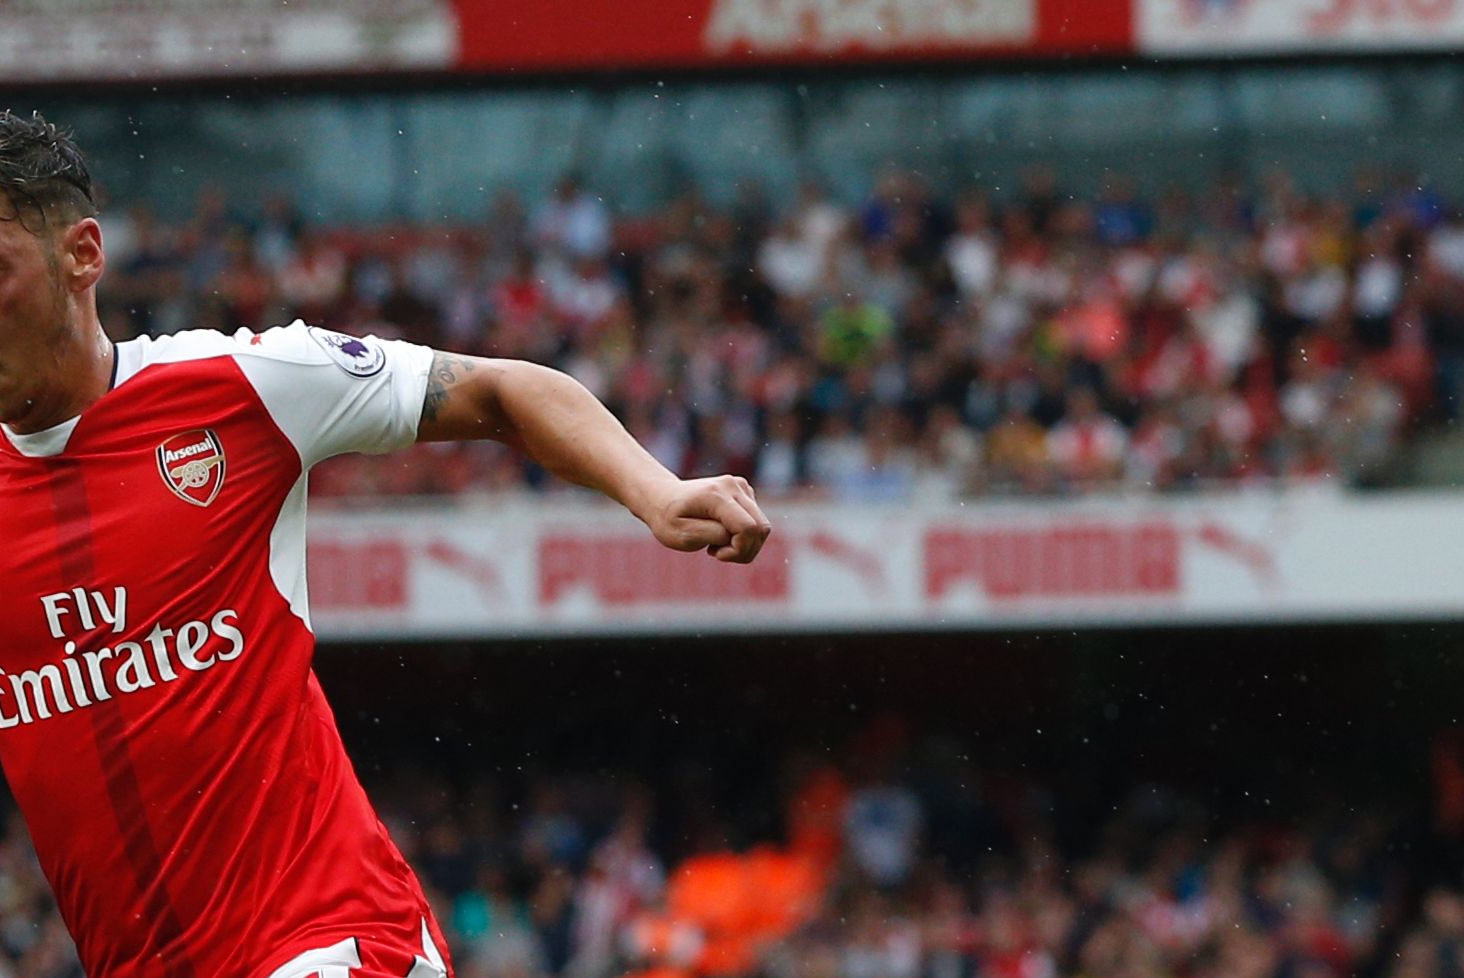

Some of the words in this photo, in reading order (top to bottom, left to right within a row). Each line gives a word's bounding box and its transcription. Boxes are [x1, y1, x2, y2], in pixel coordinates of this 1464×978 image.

[164, 437, 213, 462] Arsenal
[922, 522, 1183, 602] PUMA
[40, 586, 127, 639] Fly
